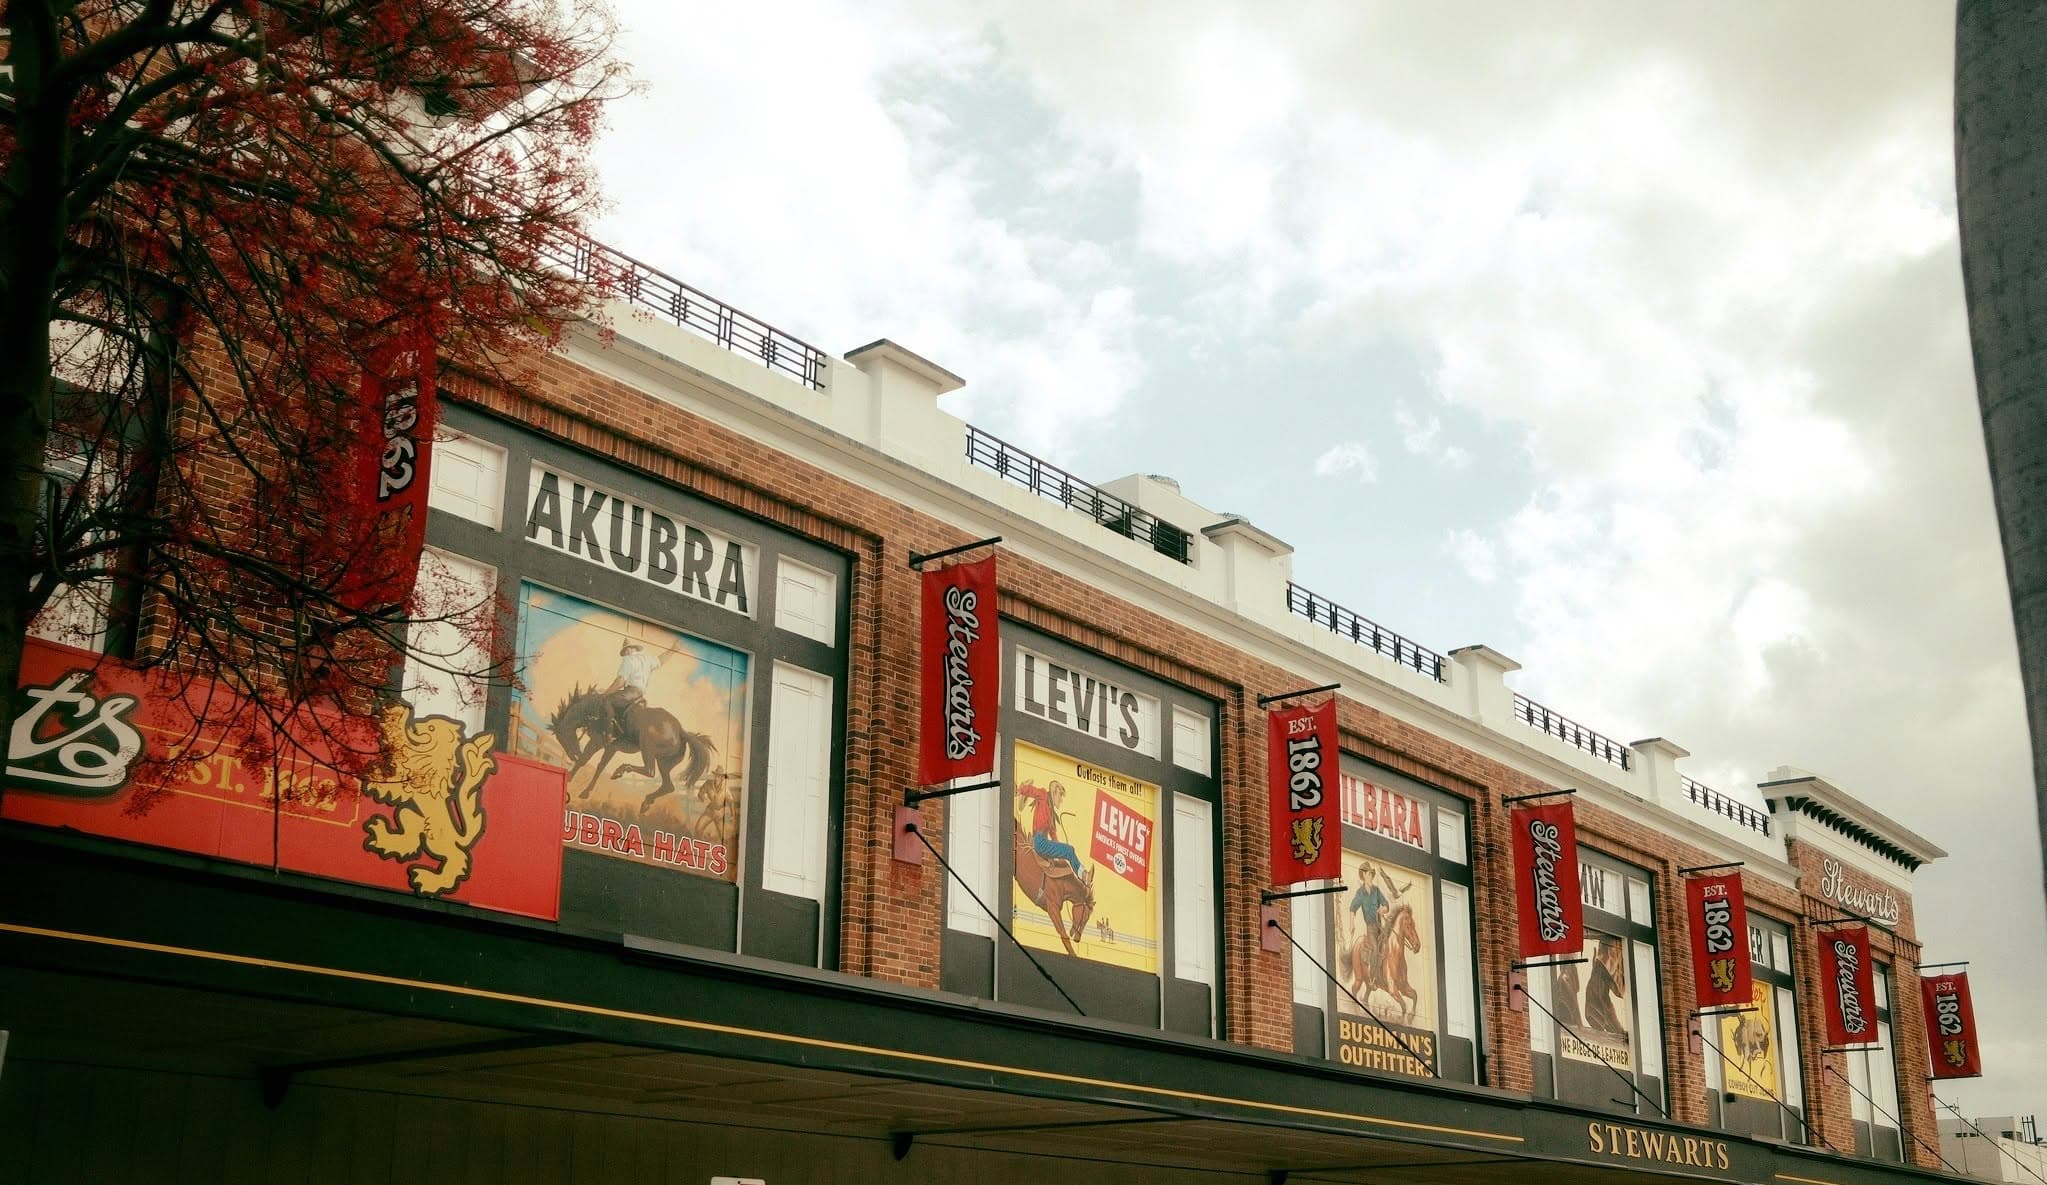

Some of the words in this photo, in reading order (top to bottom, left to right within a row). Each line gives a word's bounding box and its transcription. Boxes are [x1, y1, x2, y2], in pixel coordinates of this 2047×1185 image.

[526, 471, 748, 613] AKUBRA
[944, 586, 981, 760] Stewart's
[1024, 653, 1140, 749] LEVI'S
[1287, 716, 1317, 735] EST.
[1077, 764, 1107, 786] Outlasts
[1109, 774, 1128, 793] them
[1129, 780, 1143, 797] all!
[1288, 736, 1321, 810] 1862
[1100, 799, 1147, 853] LEVI'S
[653, 829, 728, 875] HATS
[1703, 884, 1728, 898] EST.
[1821, 858, 1899, 925] Stewart's
[1704, 899, 1733, 953] 1862
[1935, 981, 1956, 992] EST.
[1936, 993, 1962, 1036] 1862
[1339, 1019, 1433, 1057] BUSHMAN'S
[1339, 1043, 1434, 1079] OUTFITTERS
[1601, 1045, 1630, 1067] LEATHER
[1587, 1121, 1730, 1170] STEWARTS
